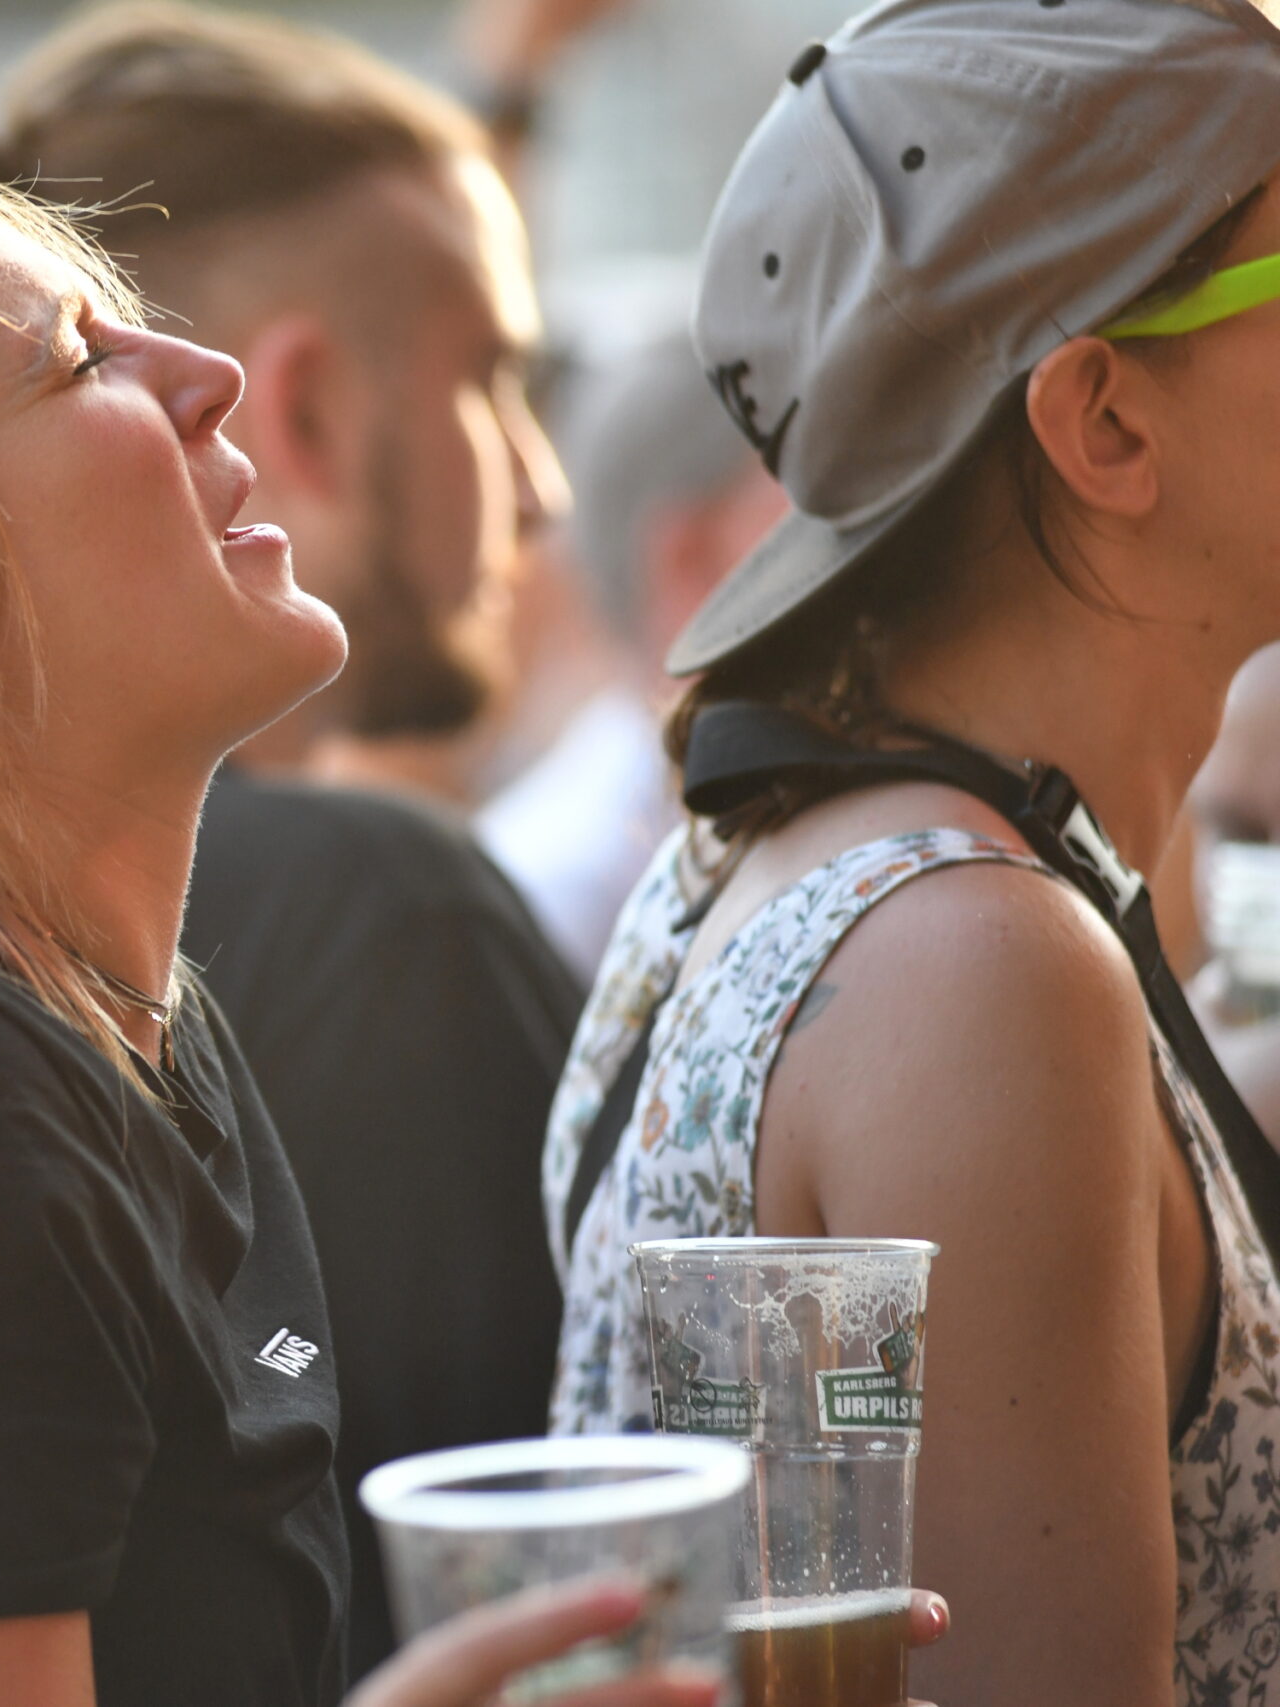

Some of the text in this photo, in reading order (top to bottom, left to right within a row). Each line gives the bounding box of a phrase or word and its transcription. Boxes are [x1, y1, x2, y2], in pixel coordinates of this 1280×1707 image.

[254, 1327, 319, 1378] VANS
[833, 1376, 897, 1393] KARLSBERG
[834, 1396, 909, 1420] URPILS
